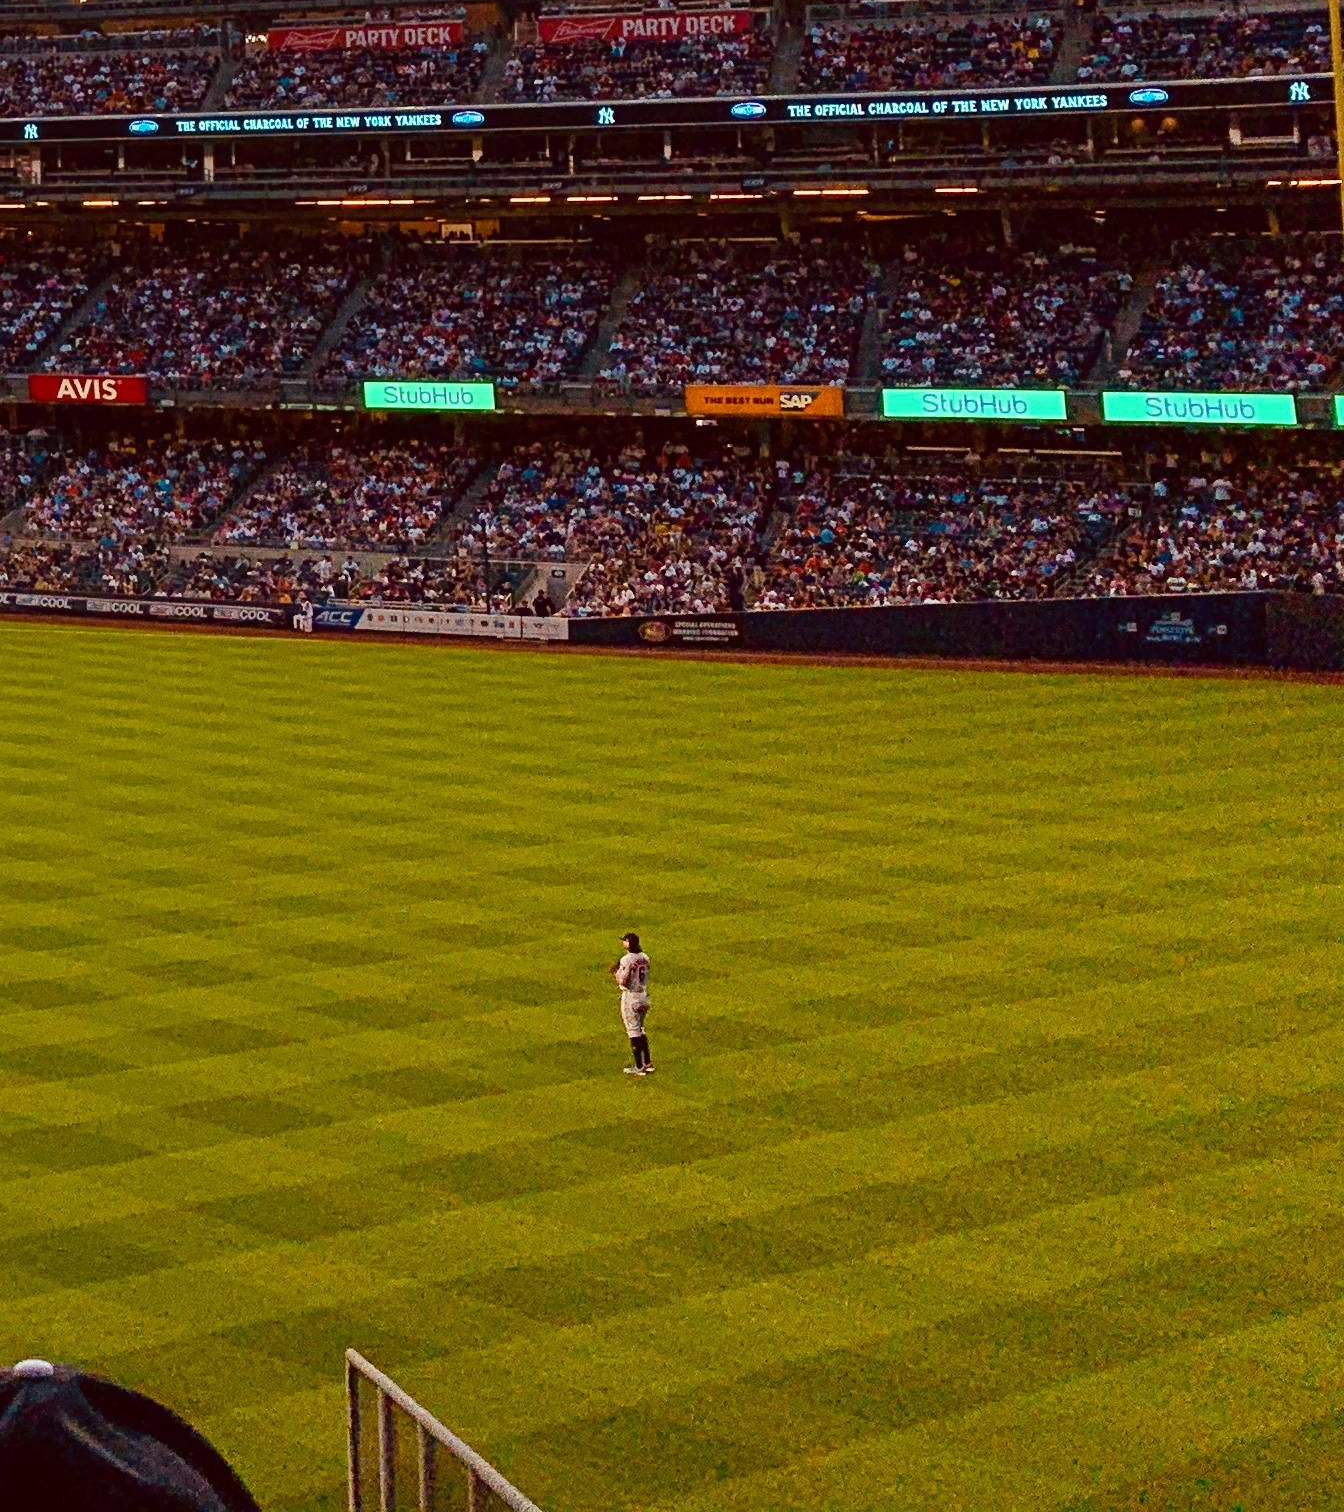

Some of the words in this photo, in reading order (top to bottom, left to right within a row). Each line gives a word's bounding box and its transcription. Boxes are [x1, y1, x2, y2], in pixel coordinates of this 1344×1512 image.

[621, 14, 682, 39] PARTY
[685, 13, 736, 34] DECK
[344, 25, 400, 50] PARTY
[403, 23, 452, 48] DECK
[788, 105, 811, 116] THE
[815, 104, 865, 116] OFFICIAL
[868, 102, 929, 114] CHARCOAL
[933, 101, 948, 113] OF
[952, 100, 977, 112] THE
[981, 99, 1009, 111] NEW
[1014, 98, 1047, 110] YORK
[1052, 95, 1107, 108] YANKEES
[176, 121, 196, 131] THE
[199, 120, 240, 131] OFFICIAL
[244, 119, 293, 129] CHARCOAL
[296, 118, 309, 128] OF
[312, 117, 333, 128] THE
[336, 117, 360, 127] NEW
[364, 116, 391, 126] YORK
[395, 114, 441, 126] YANKEES
[56, 378, 118, 400] AVIS
[384, 385, 474, 405] StubHub
[704, 396, 722, 405] THE
[725, 396, 750, 405] BEST
[753, 397, 774, 405] RUN
[779, 393, 812, 410] SAP
[922, 393, 1028, 414] StubHub
[1145, 397, 1256, 419] StubHub
[40, 596, 71, 609] COOL
[112, 602, 143, 614] COOL
[174, 606, 207, 617] COOL
[239, 610, 271, 621] COOL
[315, 610, 352, 623] ACC
